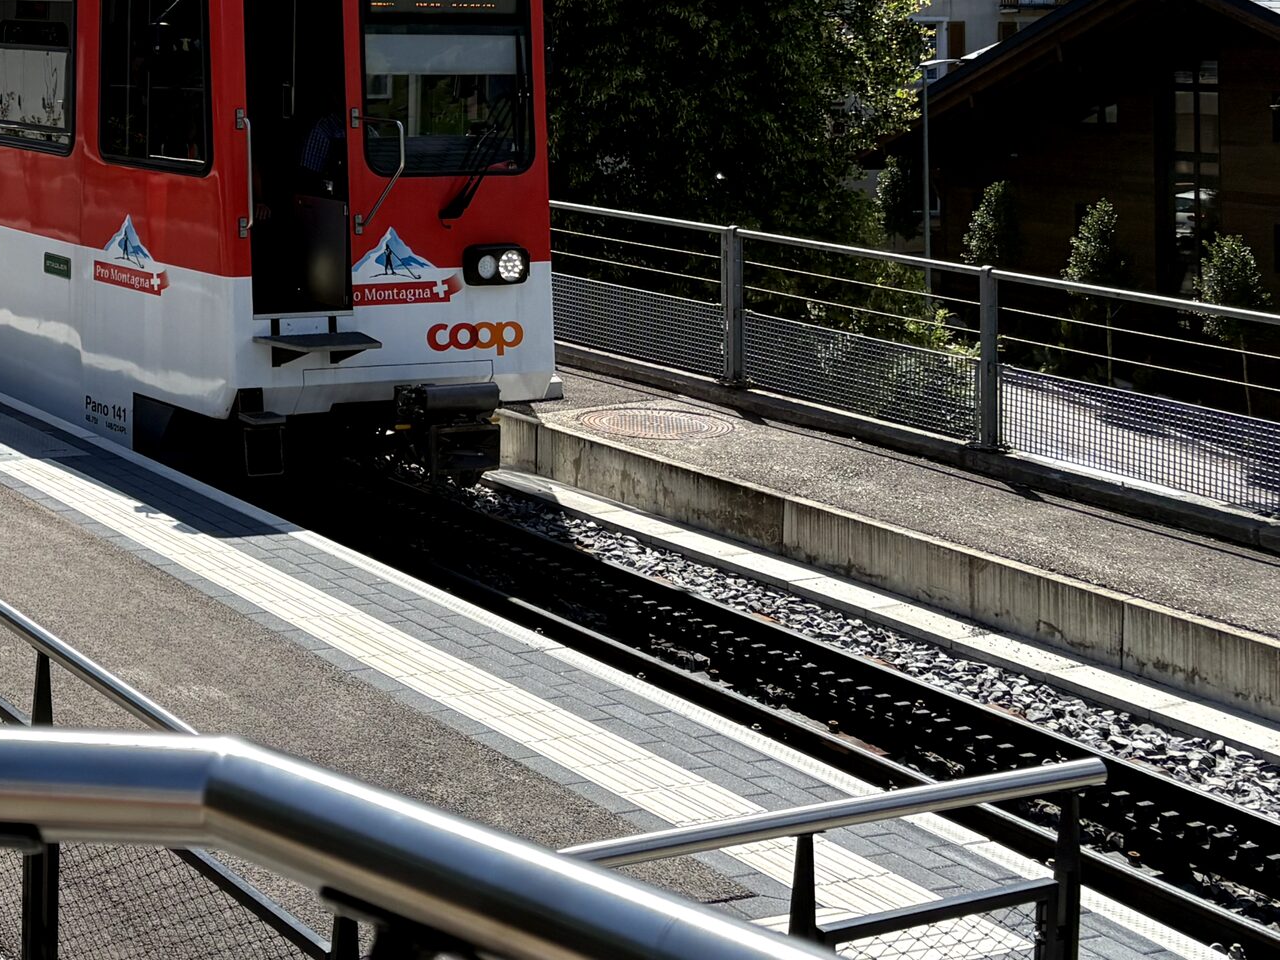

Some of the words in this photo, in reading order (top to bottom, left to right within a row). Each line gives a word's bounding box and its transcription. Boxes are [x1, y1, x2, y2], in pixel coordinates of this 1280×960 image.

[96, 265, 109, 279] Pro
[111, 268, 150, 289] Montagna
[364, 287, 431, 302] Montagna
[426, 320, 524, 356] coop
[85, 395, 109, 417] Pano
[111, 404, 127, 423] 141
